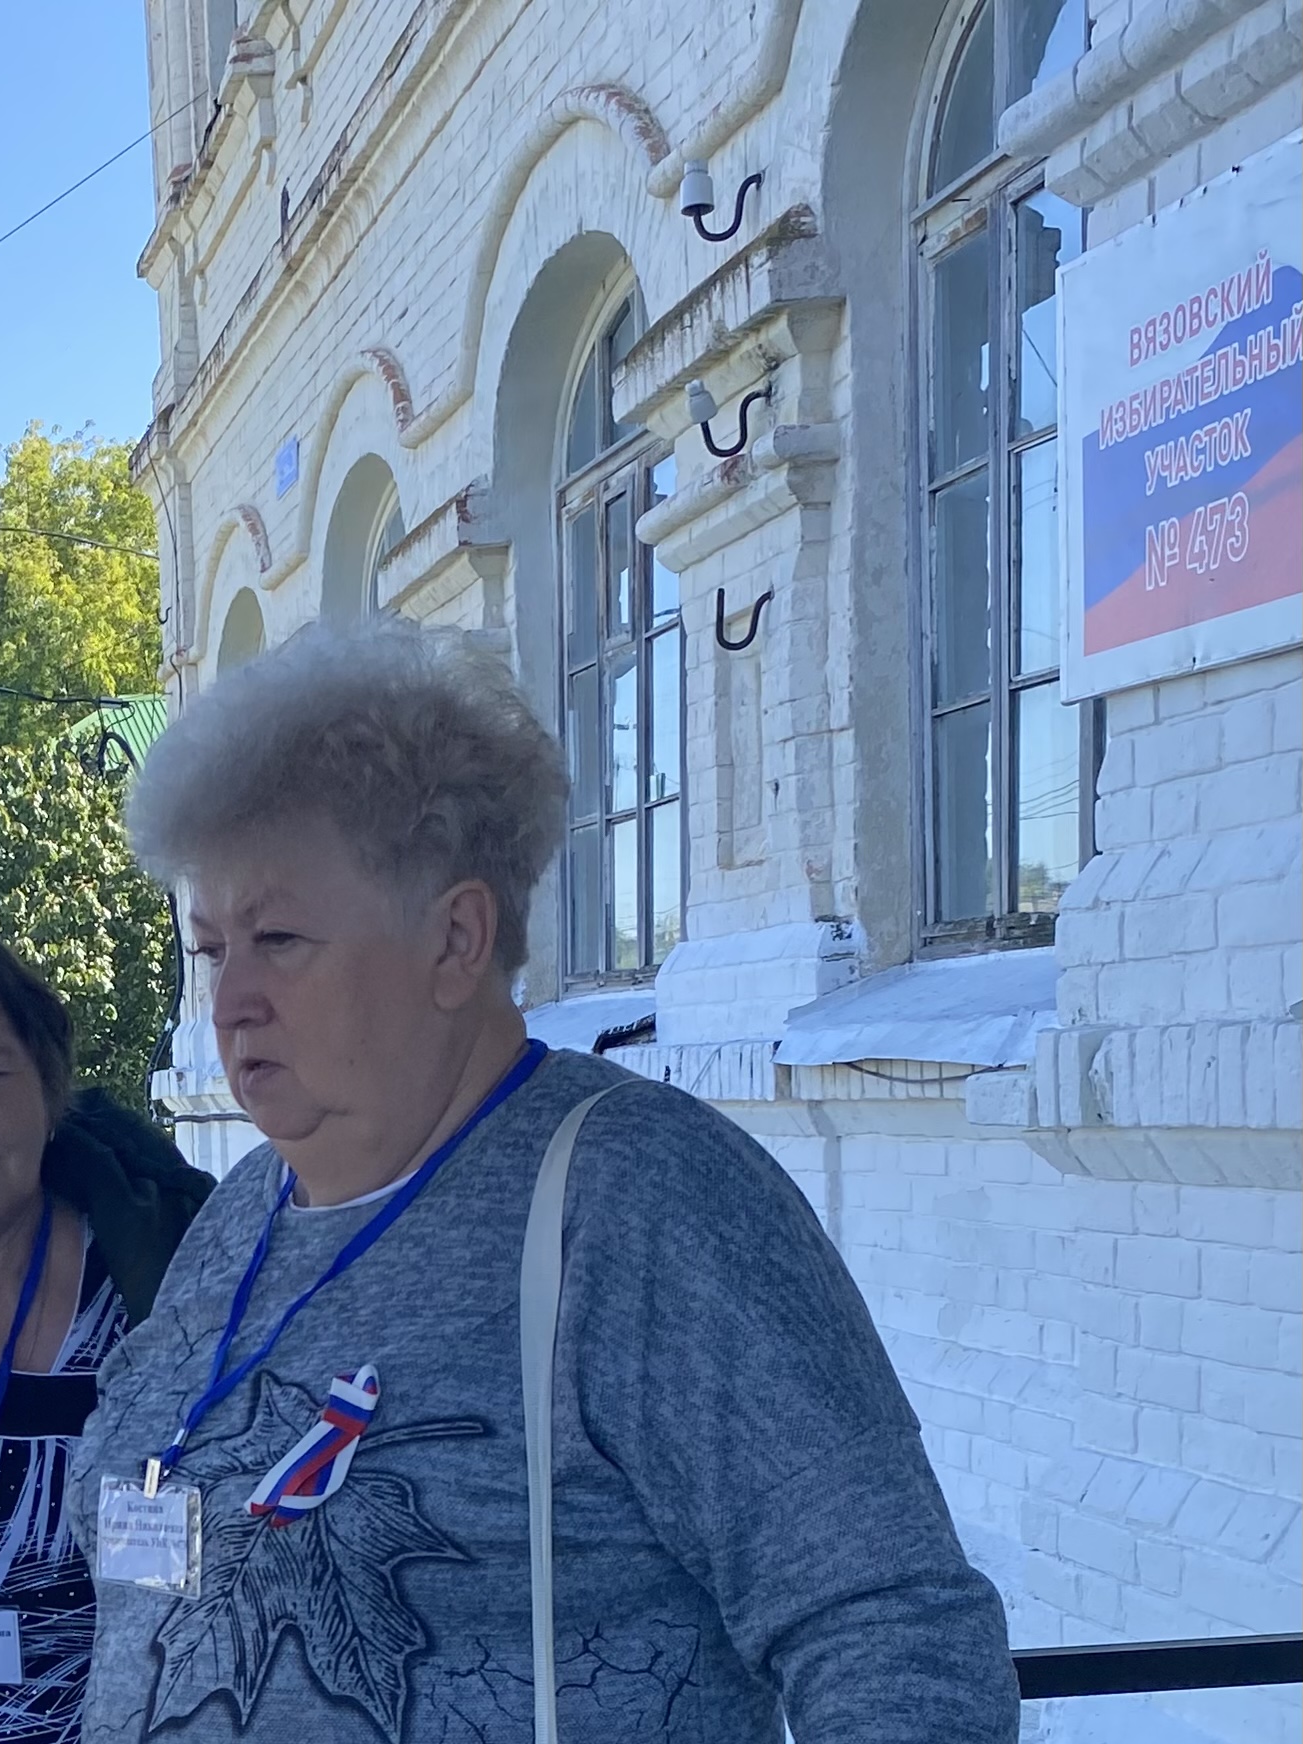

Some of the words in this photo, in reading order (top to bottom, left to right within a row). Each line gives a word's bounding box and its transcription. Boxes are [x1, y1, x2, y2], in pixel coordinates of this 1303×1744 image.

[1128, 249, 1273, 368] ВЯЗОВСКИЙ
[1099, 301, 1303, 450] ИЗБИРАТЕЛЬНЫЙ
[1144, 408, 1251, 495] УЧАСТОК
[1146, 517, 1180, 591] №
[1186, 491, 1248, 575] 473
